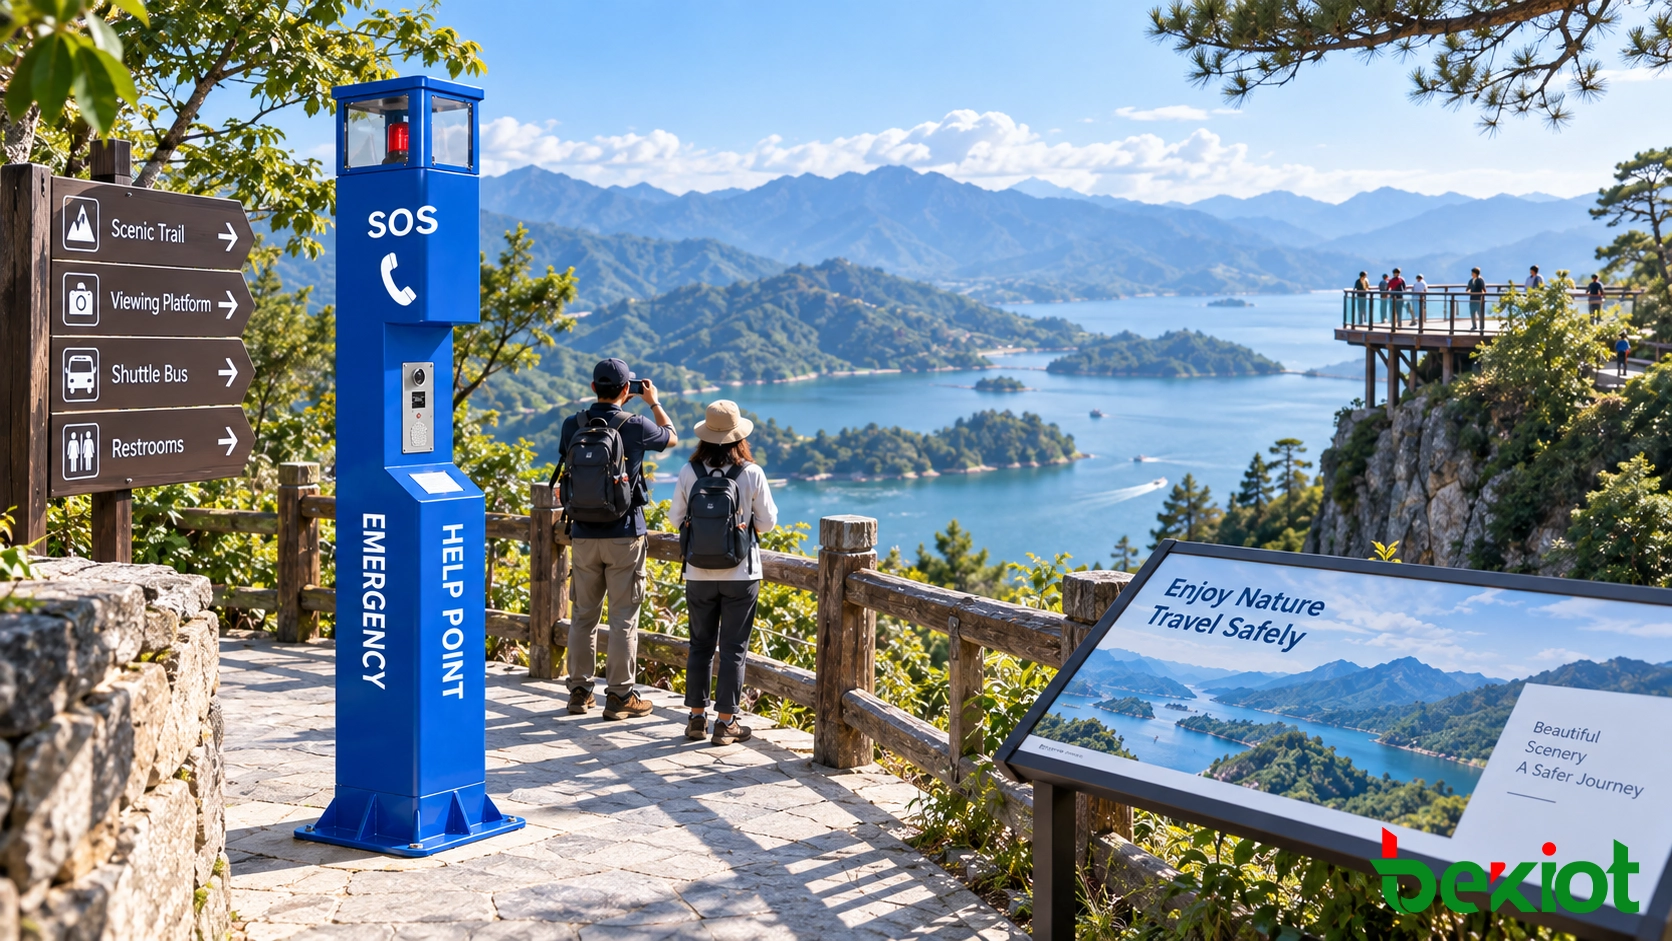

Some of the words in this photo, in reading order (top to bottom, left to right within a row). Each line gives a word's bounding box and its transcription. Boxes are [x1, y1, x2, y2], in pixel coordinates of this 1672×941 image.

[111, 218, 155, 241] Scenic
[157, 223, 185, 243] Trail
[367, 205, 439, 239] SOS
[110, 290, 160, 316] Viewing
[163, 293, 212, 312] Platform
[111, 363, 161, 384] Shuttle
[164, 365, 188, 383] Bus
[112, 438, 185, 458] Restrooms
[442, 523, 464, 598] HELP
[362, 513, 386, 690] EMERGENCY
[1164, 577, 1234, 608] Enjoy
[1235, 586, 1326, 616] Nature
[1147, 604, 1225, 635] Travel
[1222, 616, 1307, 653] Safely
[442, 607, 465, 700] POINT
[1533, 720, 1601, 743] Beautiful
[1525, 740, 1588, 766] Scenery
[1515, 760, 1527, 775] A
[1532, 763, 1573, 784] Safer
[1575, 772, 1645, 800] Journey
